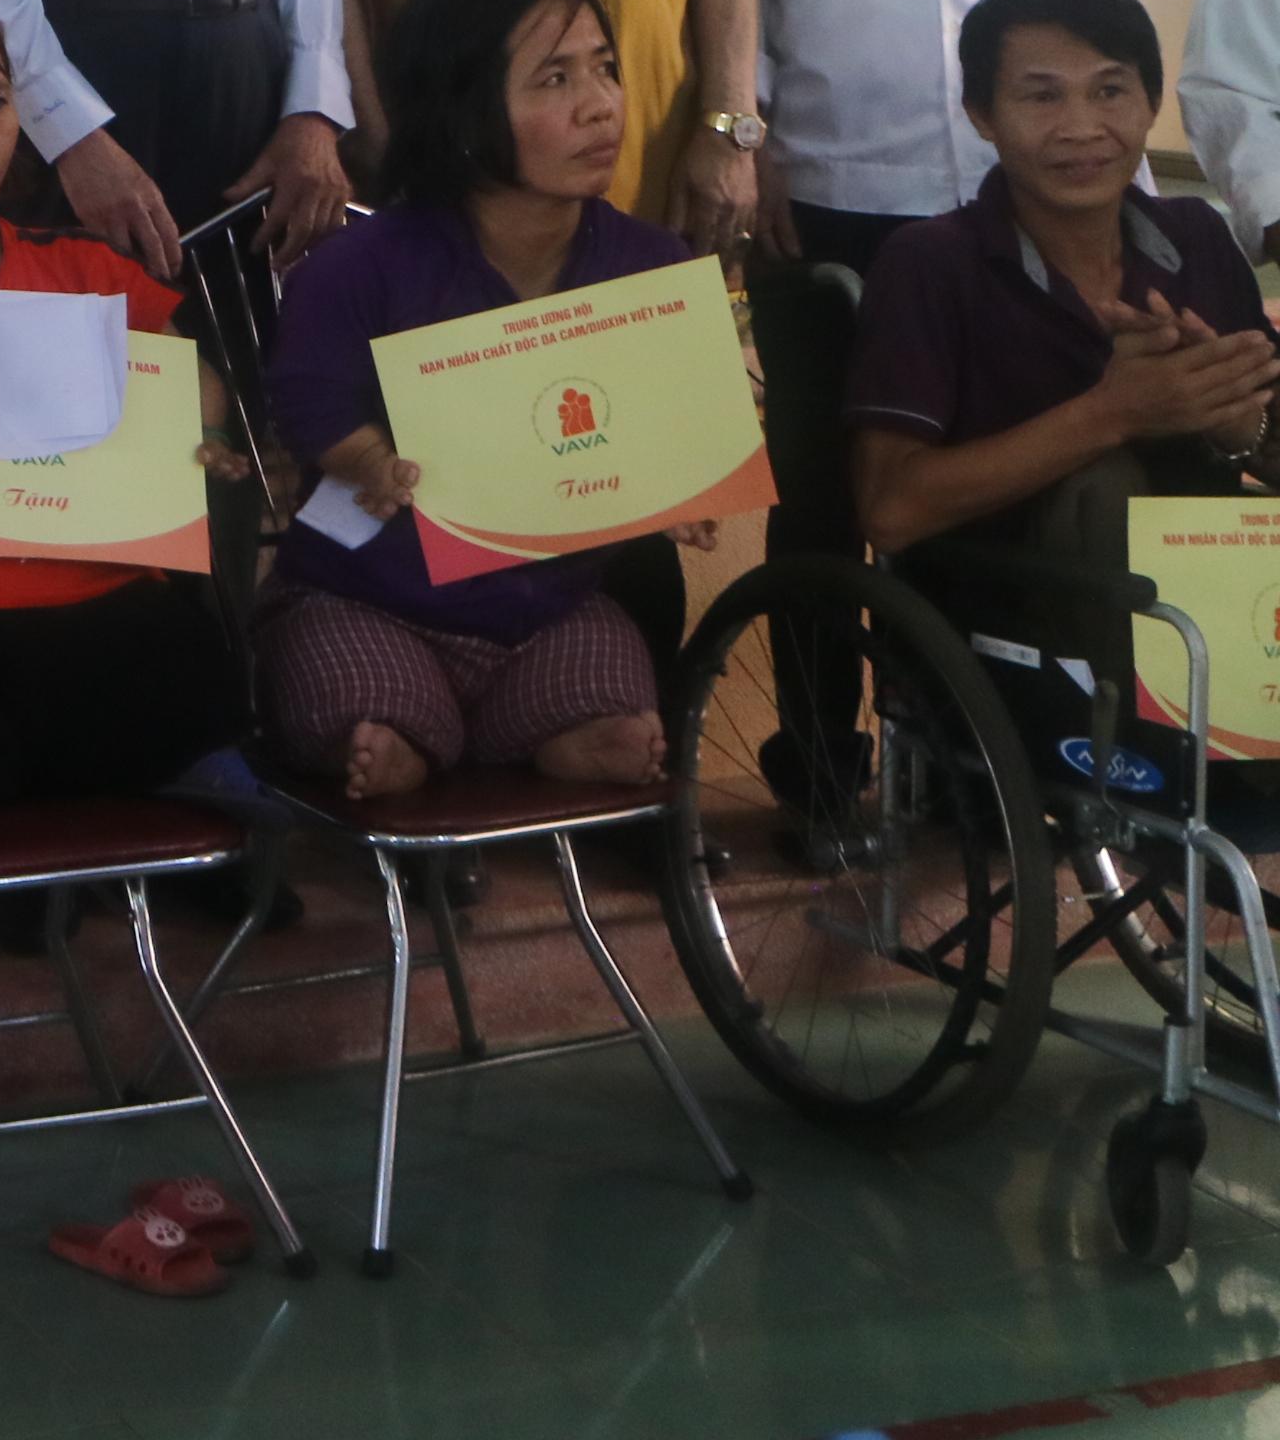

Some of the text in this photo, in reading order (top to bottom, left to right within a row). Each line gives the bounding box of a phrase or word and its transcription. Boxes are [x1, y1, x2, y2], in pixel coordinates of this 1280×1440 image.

[552, 430, 608, 456] VAVA
[556, 476, 619, 498] Tặng
[5, 488, 68, 511] Tặng
